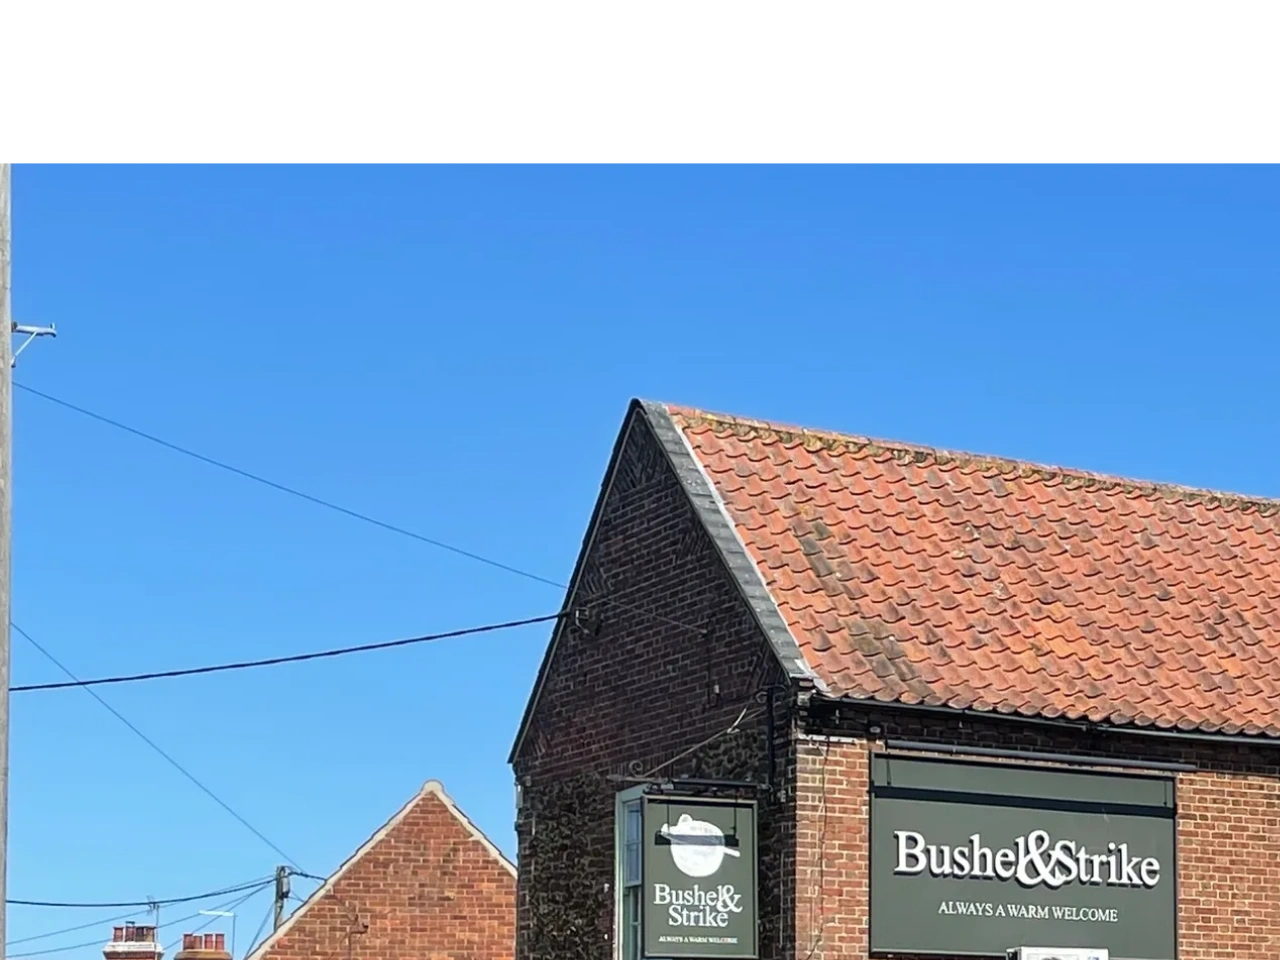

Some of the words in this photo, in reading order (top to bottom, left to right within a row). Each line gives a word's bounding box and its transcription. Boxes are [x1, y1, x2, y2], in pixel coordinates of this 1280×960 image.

[668, 905, 729, 927] Strike
[938, 901, 993, 916] ALWAYS
[995, 903, 1006, 917] A
[1007, 904, 1049, 919] WARM
[1052, 906, 1118, 922] WELCOME
